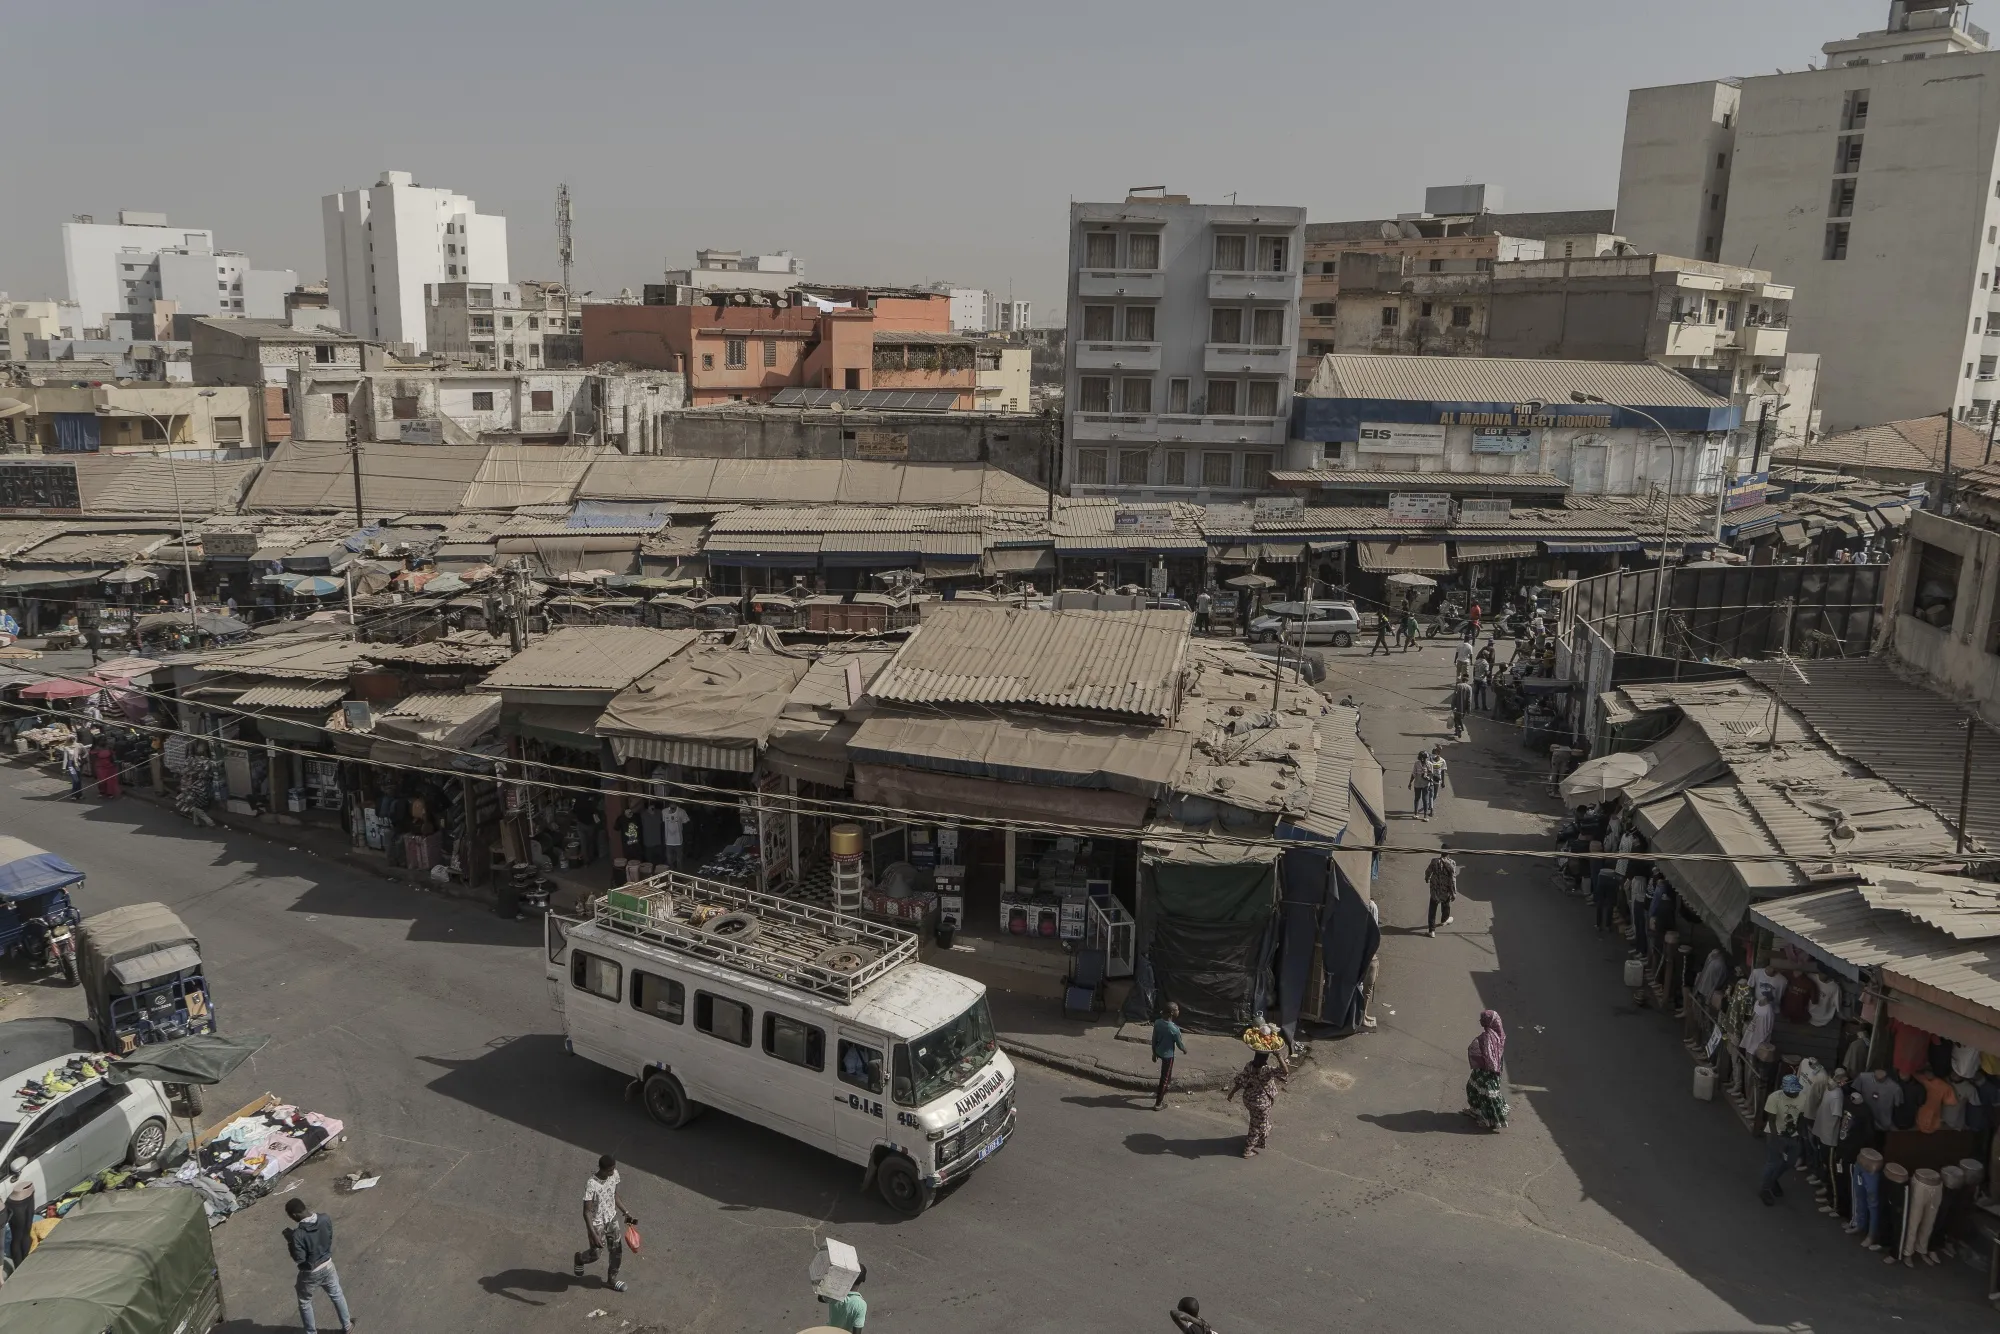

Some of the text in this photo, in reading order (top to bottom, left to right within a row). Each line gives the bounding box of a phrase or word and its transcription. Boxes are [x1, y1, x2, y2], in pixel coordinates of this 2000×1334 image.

[1440, 412, 1454, 425] AL
[1460, 412, 1511, 426] MADINA
[1360, 429, 1392, 440] EIS
[848, 1093, 884, 1119] G.I.E
